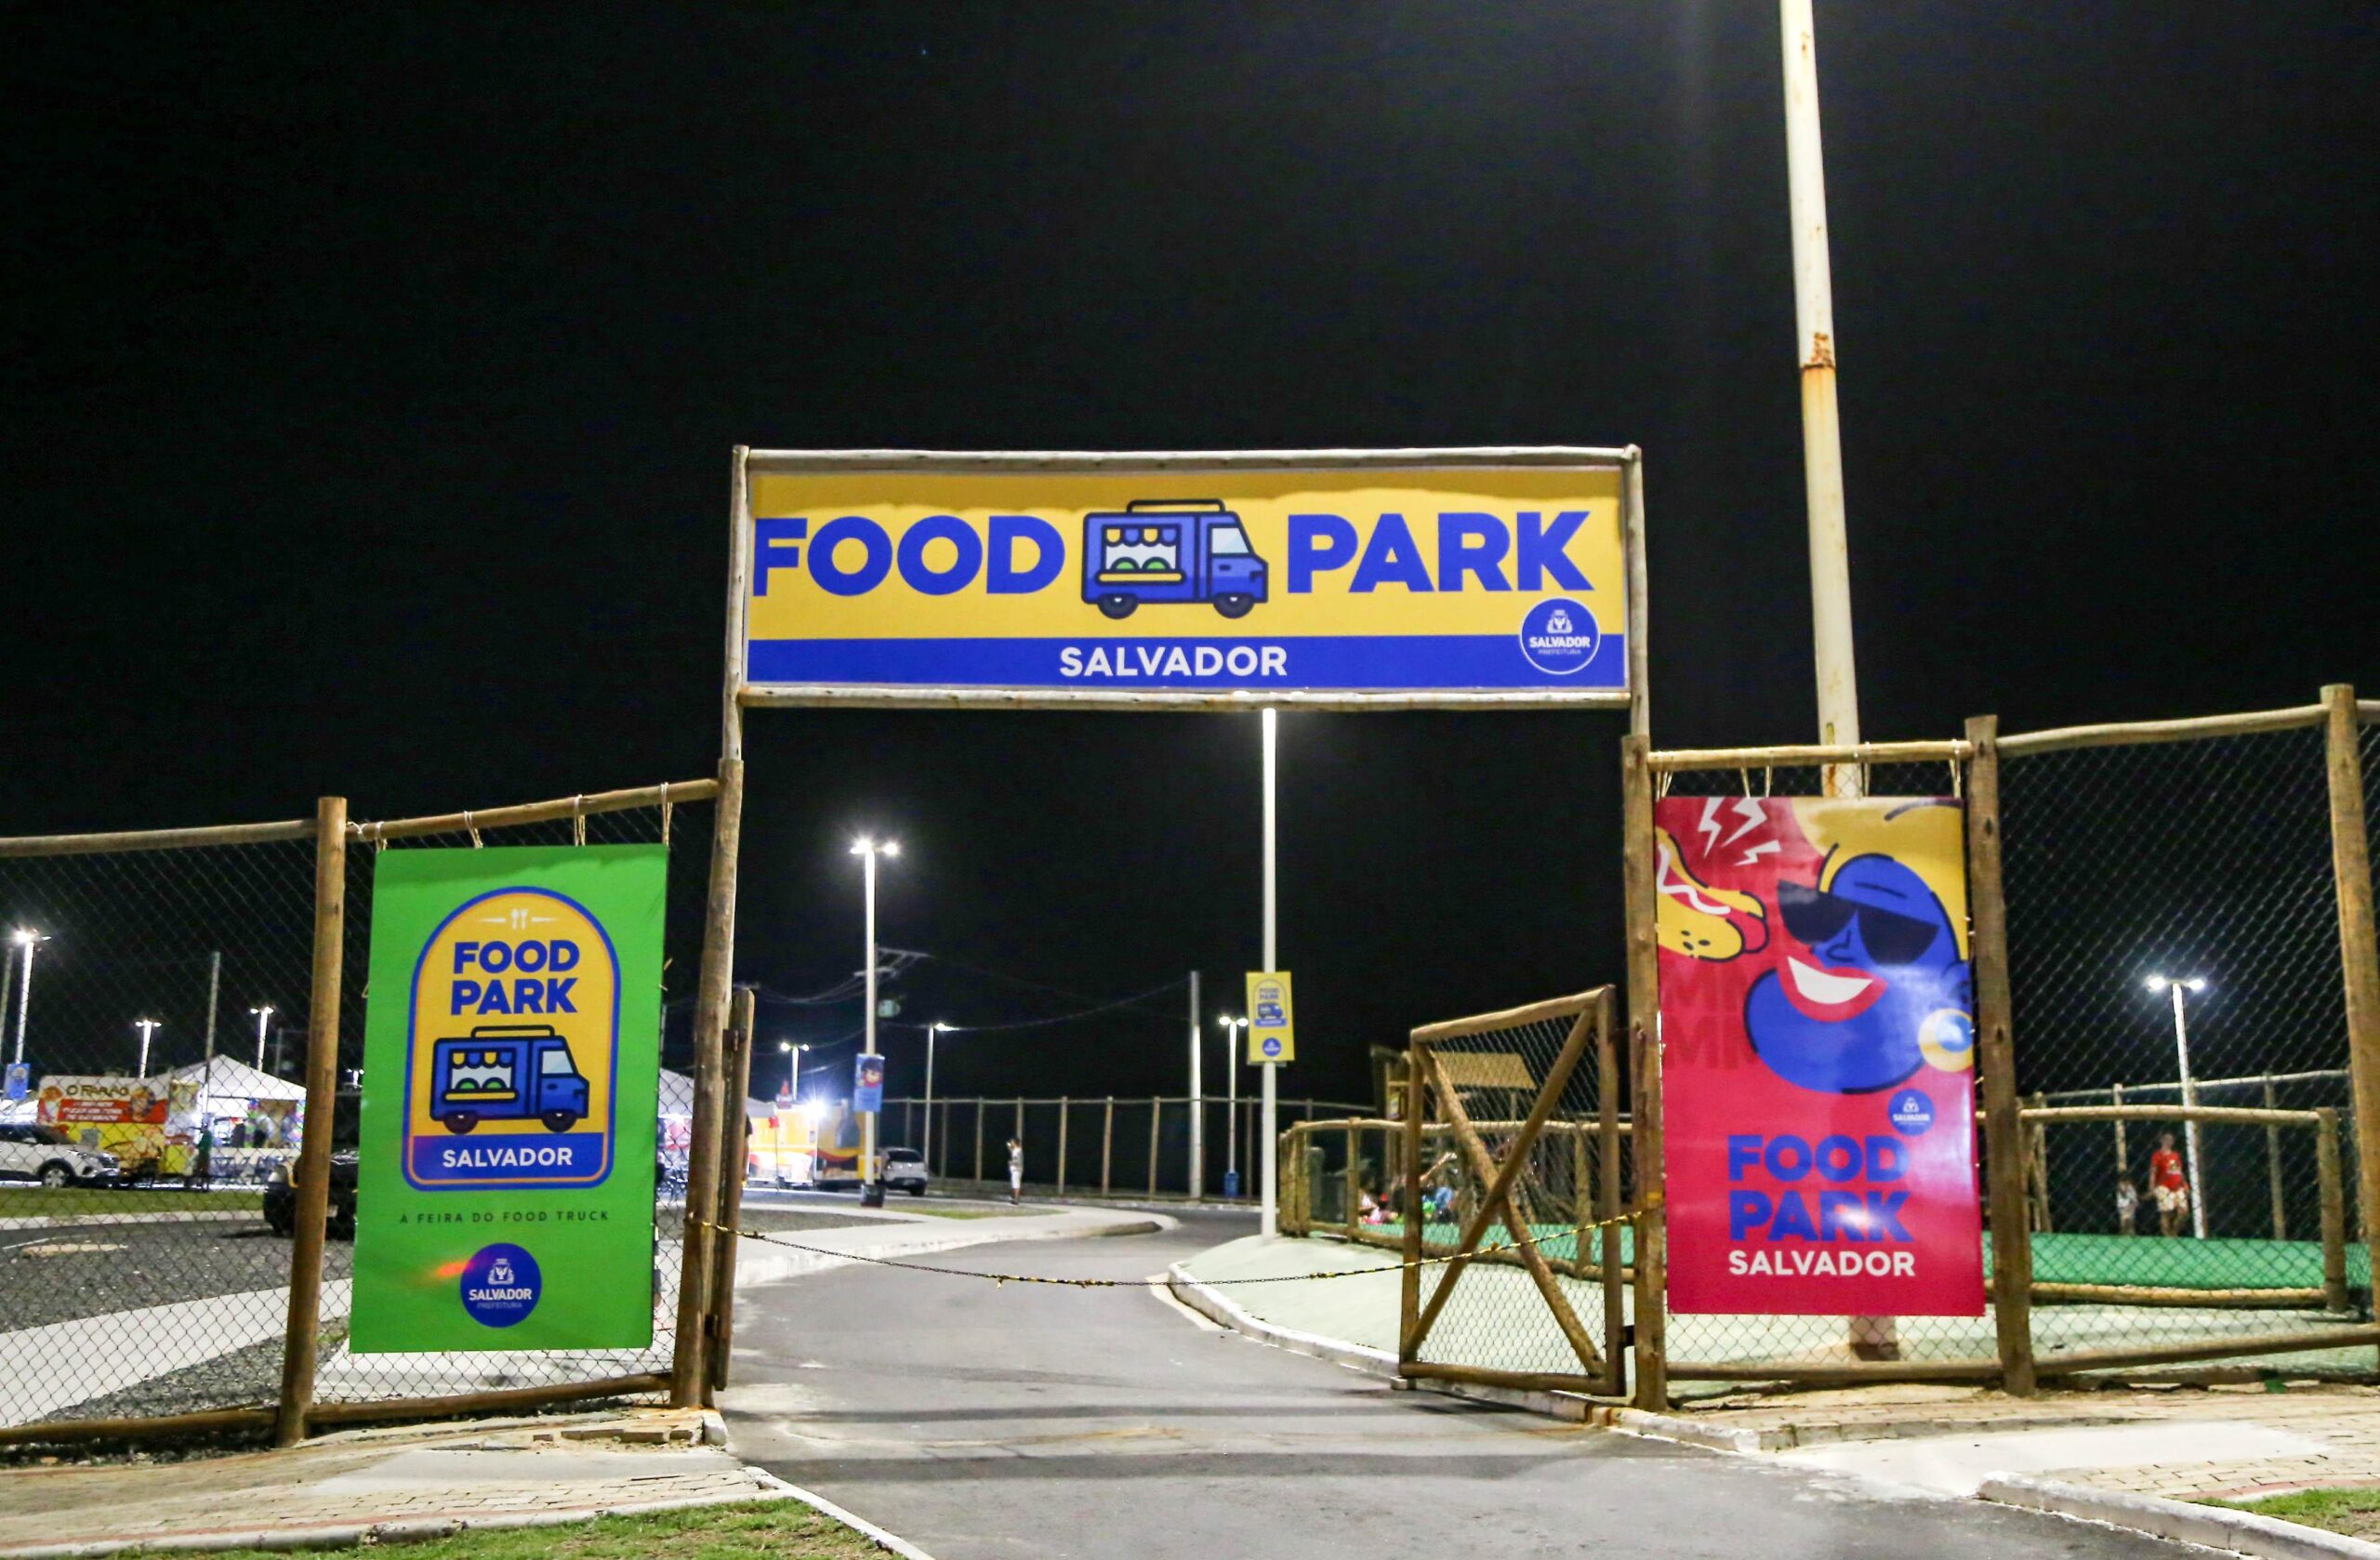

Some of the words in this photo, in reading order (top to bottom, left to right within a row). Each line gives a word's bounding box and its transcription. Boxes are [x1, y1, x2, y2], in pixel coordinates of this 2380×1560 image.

[753, 514, 1065, 597] FOOD
[1288, 510, 1595, 593] PARK
[1529, 636, 1591, 648] SALVADOR
[1059, 646, 1289, 677] SALVADOR
[453, 939, 580, 974] FOOD
[451, 977, 578, 1015] PARK
[443, 1147, 573, 1169] SALVADOR
[1728, 1134, 1910, 1183] FOOD
[400, 1214, 409, 1223] A
[417, 1213, 463, 1223] FEIRA
[472, 1212, 494, 1223] DO
[503, 1211, 549, 1222] FOOD
[557, 1210, 609, 1221] TRUCK
[1729, 1190, 1915, 1242] PARK
[1728, 1249, 1915, 1276] SALVADOR
[469, 1289, 532, 1301] SALVADOR
